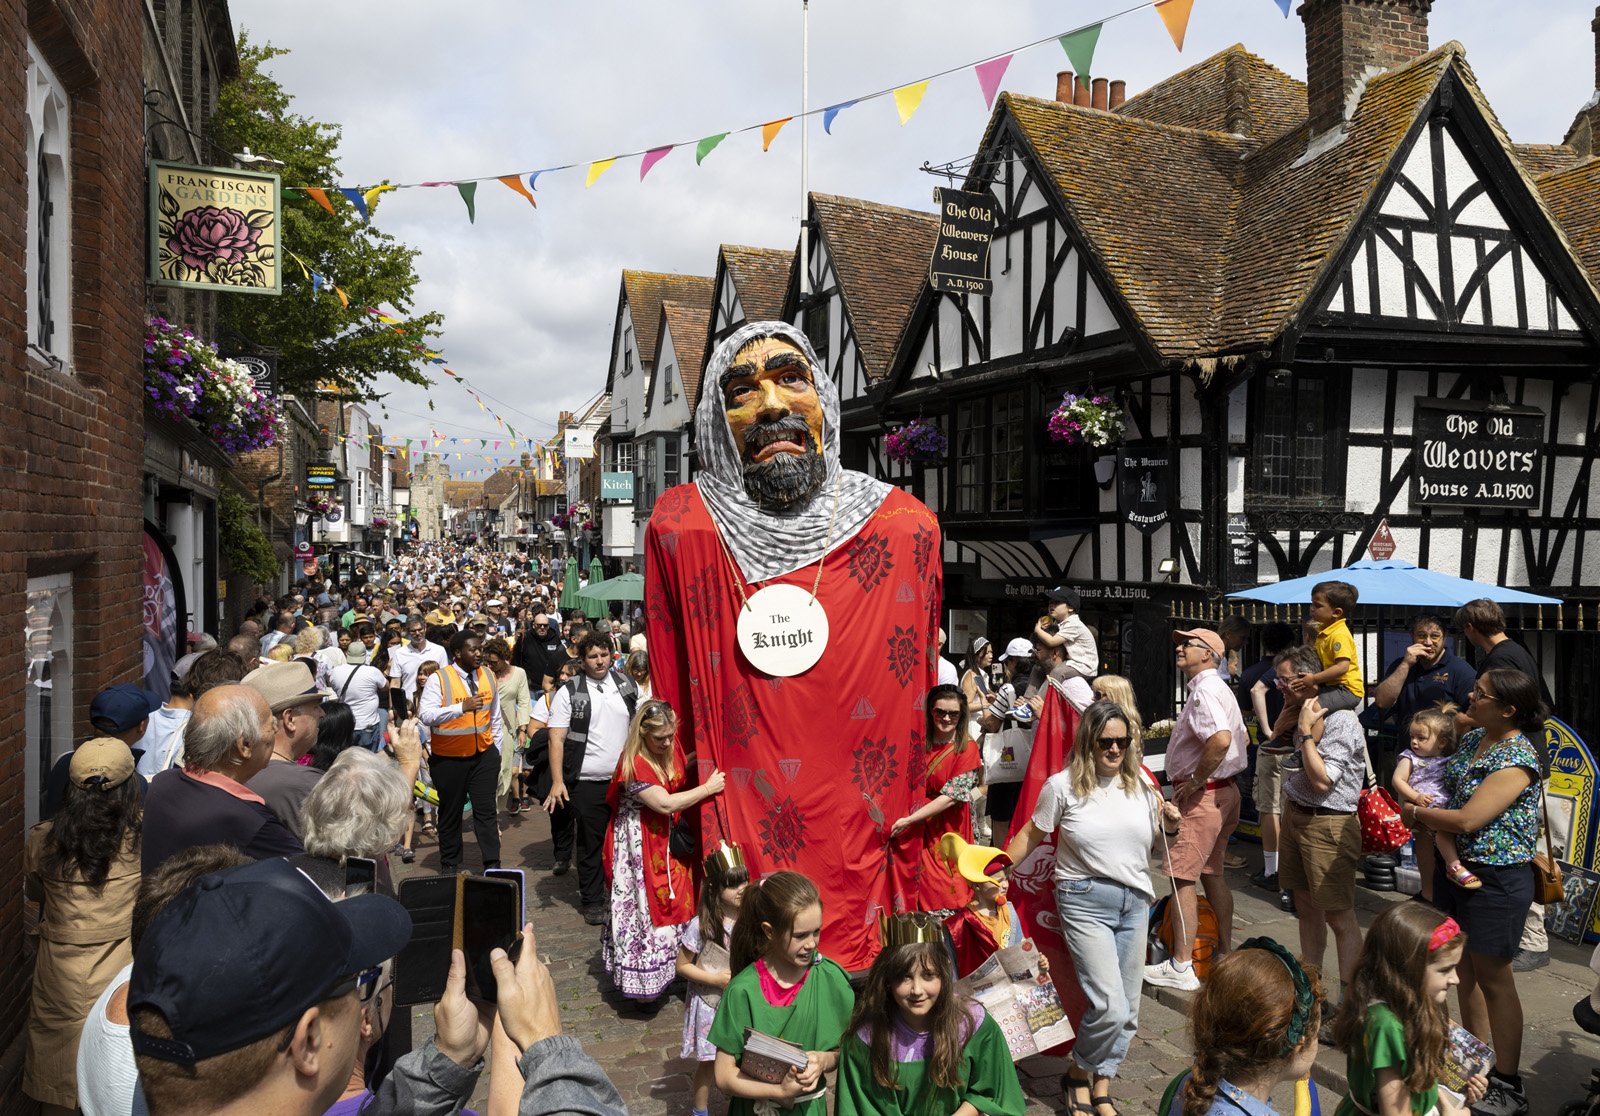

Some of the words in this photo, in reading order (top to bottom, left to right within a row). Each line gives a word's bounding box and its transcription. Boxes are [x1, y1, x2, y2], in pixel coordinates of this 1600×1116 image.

[167, 174, 267, 194] FRANCISCAN
[175, 186, 267, 207] GARDENS
[946, 202, 967, 219] The
[969, 206, 991, 222] Old
[942, 222, 989, 242] Weavers
[941, 244, 978, 262] House
[966, 280, 984, 290] 1500
[1446, 414, 1478, 439] The
[1487, 417, 1513, 436] Old
[1124, 457, 1137, 469] The
[1141, 457, 1169, 466] Weavers
[1423, 440, 1537, 472] Weavers'
[603, 480, 632, 490] Kitch
[1128, 510, 1169, 524] Restaurant
[1005, 583, 1019, 596] The
[1020, 584, 1034, 596] Old
[769, 614, 790, 624] The
[751, 628, 813, 649] Knight
[1548, 748, 1580, 769] Tours
